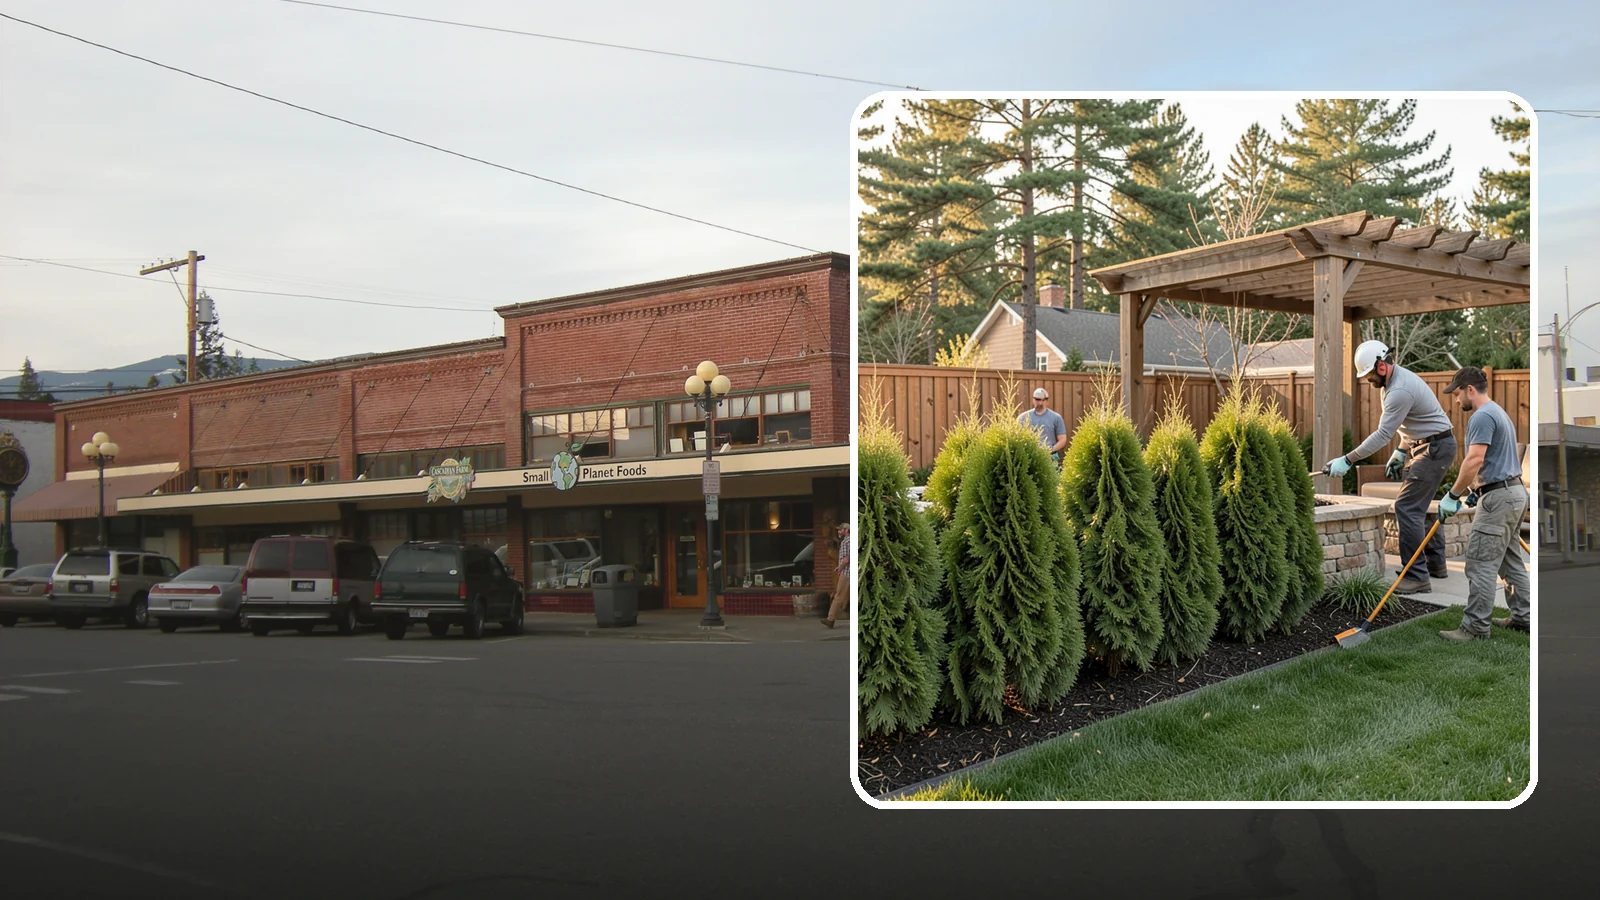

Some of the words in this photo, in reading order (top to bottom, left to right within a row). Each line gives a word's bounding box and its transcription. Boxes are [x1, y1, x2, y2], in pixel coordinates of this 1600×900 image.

[523, 470, 549, 483] Small
[583, 468, 614, 479] Planet
[617, 464, 647, 477] Foods
